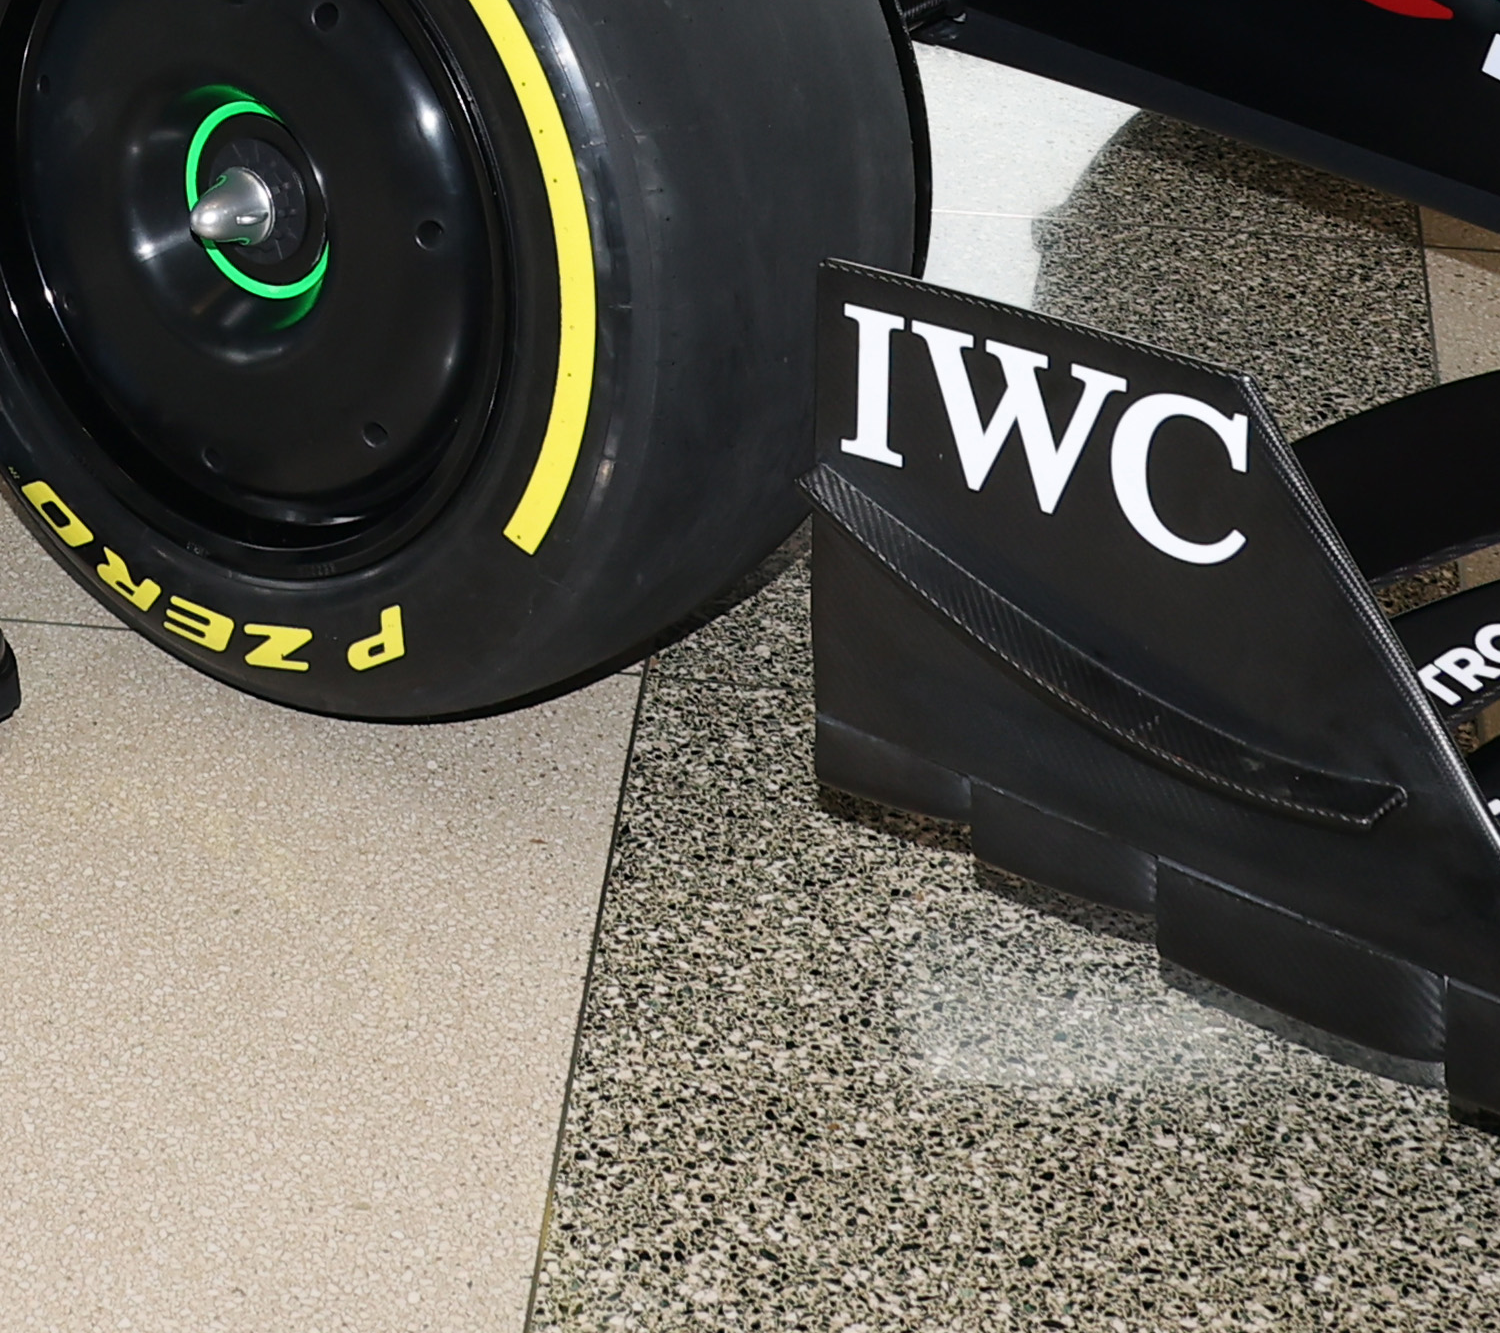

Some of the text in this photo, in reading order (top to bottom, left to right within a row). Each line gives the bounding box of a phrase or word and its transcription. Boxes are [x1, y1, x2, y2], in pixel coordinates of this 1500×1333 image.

[840, 302, 1249, 566] IWC
[21, 480, 406, 672] P ZERO
